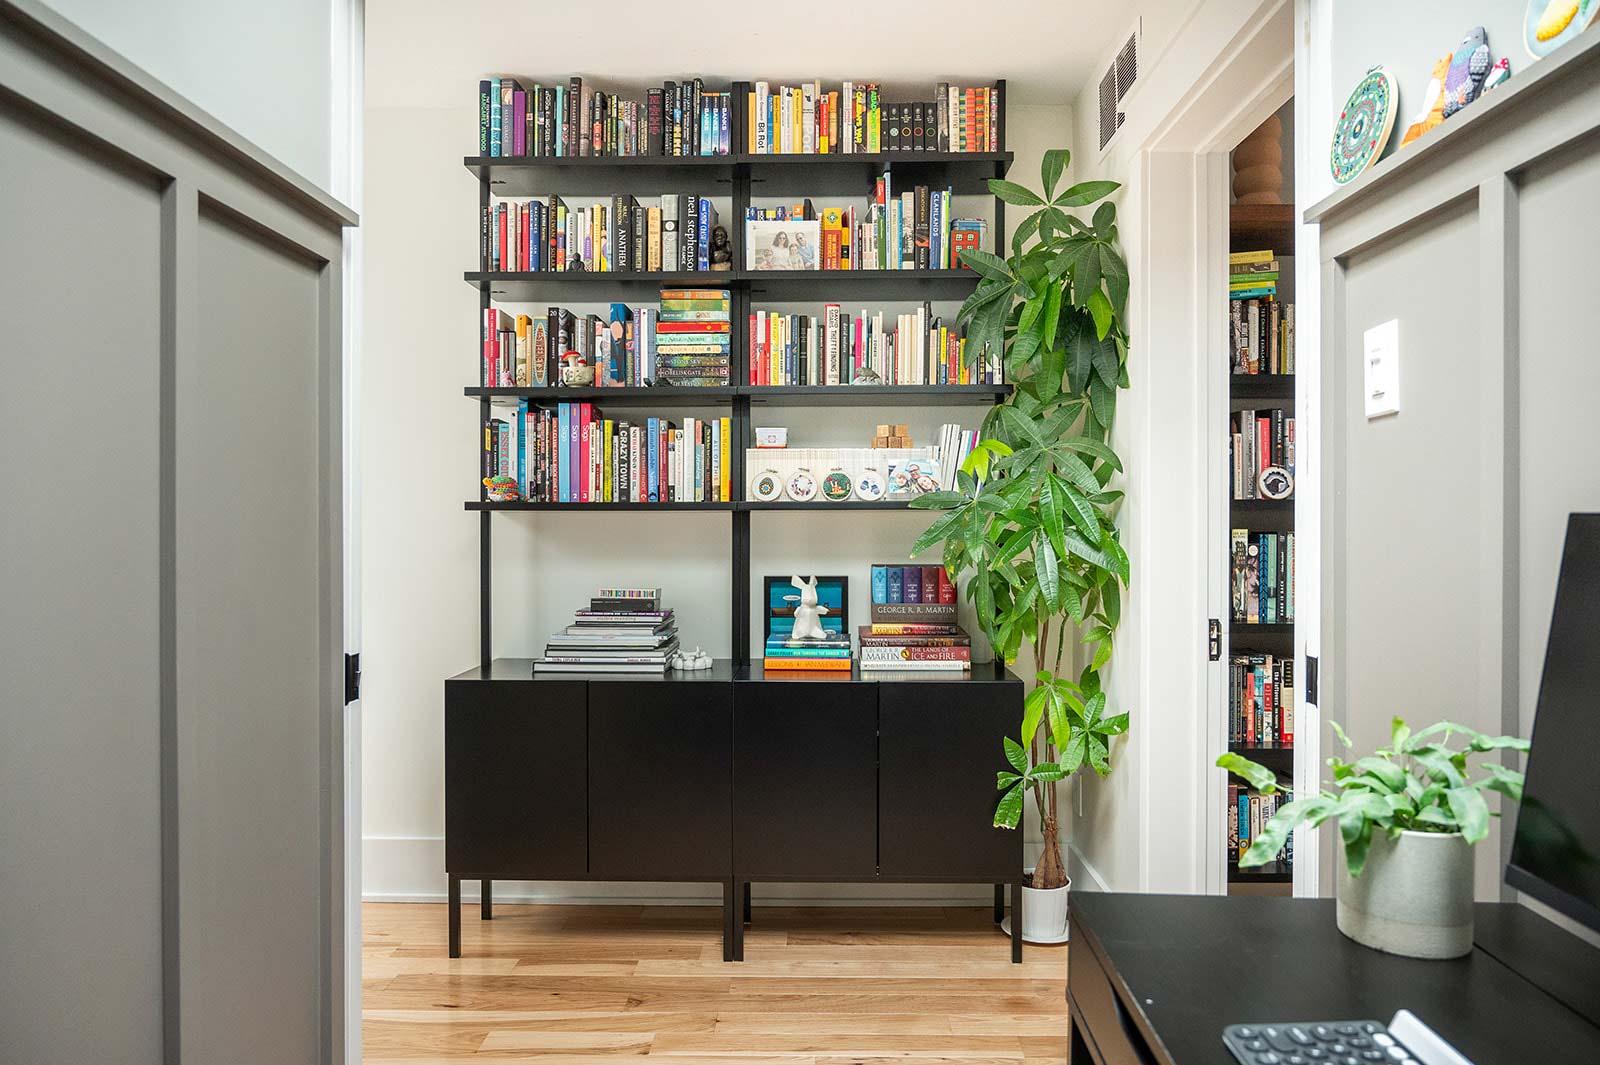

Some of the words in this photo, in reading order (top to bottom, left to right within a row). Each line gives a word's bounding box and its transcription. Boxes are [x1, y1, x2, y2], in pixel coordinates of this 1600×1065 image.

[687, 196, 697, 217] neal
[932, 193, 940, 237] CLANLANDS
[618, 228, 627, 267] ANATHEM
[689, 357, 702, 365] SKY
[664, 368, 687, 377] OBELISK
[687, 369, 702, 377] GATE
[561, 425, 570, 442] Saga
[571, 425, 580, 442] Saga
[581, 425, 590, 442] Saga
[500, 431, 509, 458] ESSEX
[620, 430, 628, 462] CRAZY
[713, 454, 719, 464] OF
[500, 459, 509, 478] COU
[620, 463, 628, 489] TOWN
[877, 606, 906, 615] GEORGE
[907, 606, 915, 615] R.
[916, 606, 924, 615] R.
[925, 606, 955, 615] MARTIN
[866, 653, 901, 661] MARTIN
